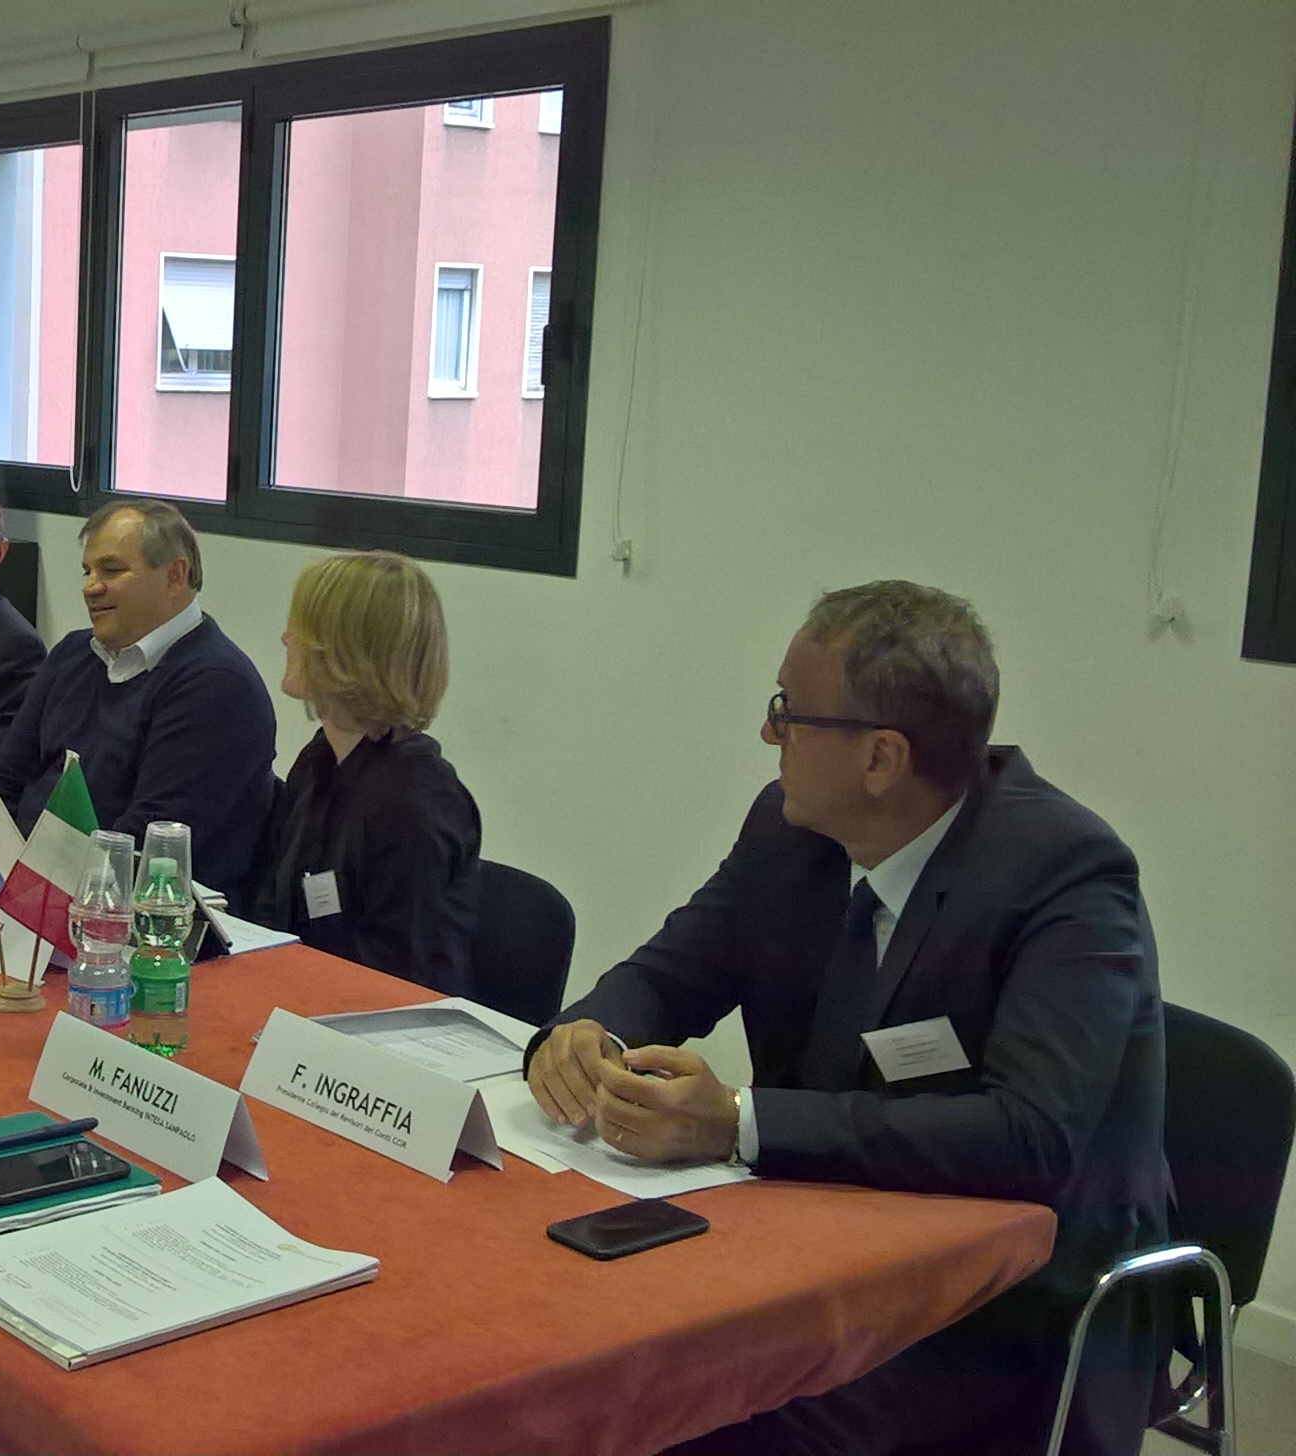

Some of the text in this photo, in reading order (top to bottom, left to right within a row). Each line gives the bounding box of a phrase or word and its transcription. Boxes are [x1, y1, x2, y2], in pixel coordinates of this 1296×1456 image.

[88, 1056, 179, 1115] M. FANUZZI
[290, 1063, 412, 1134] F. INGRAFFIA
[122, 1101, 144, 1119] Banking
[144, 1112, 164, 1127] INTESA
[164, 1121, 196, 1142] SANPAOLO
